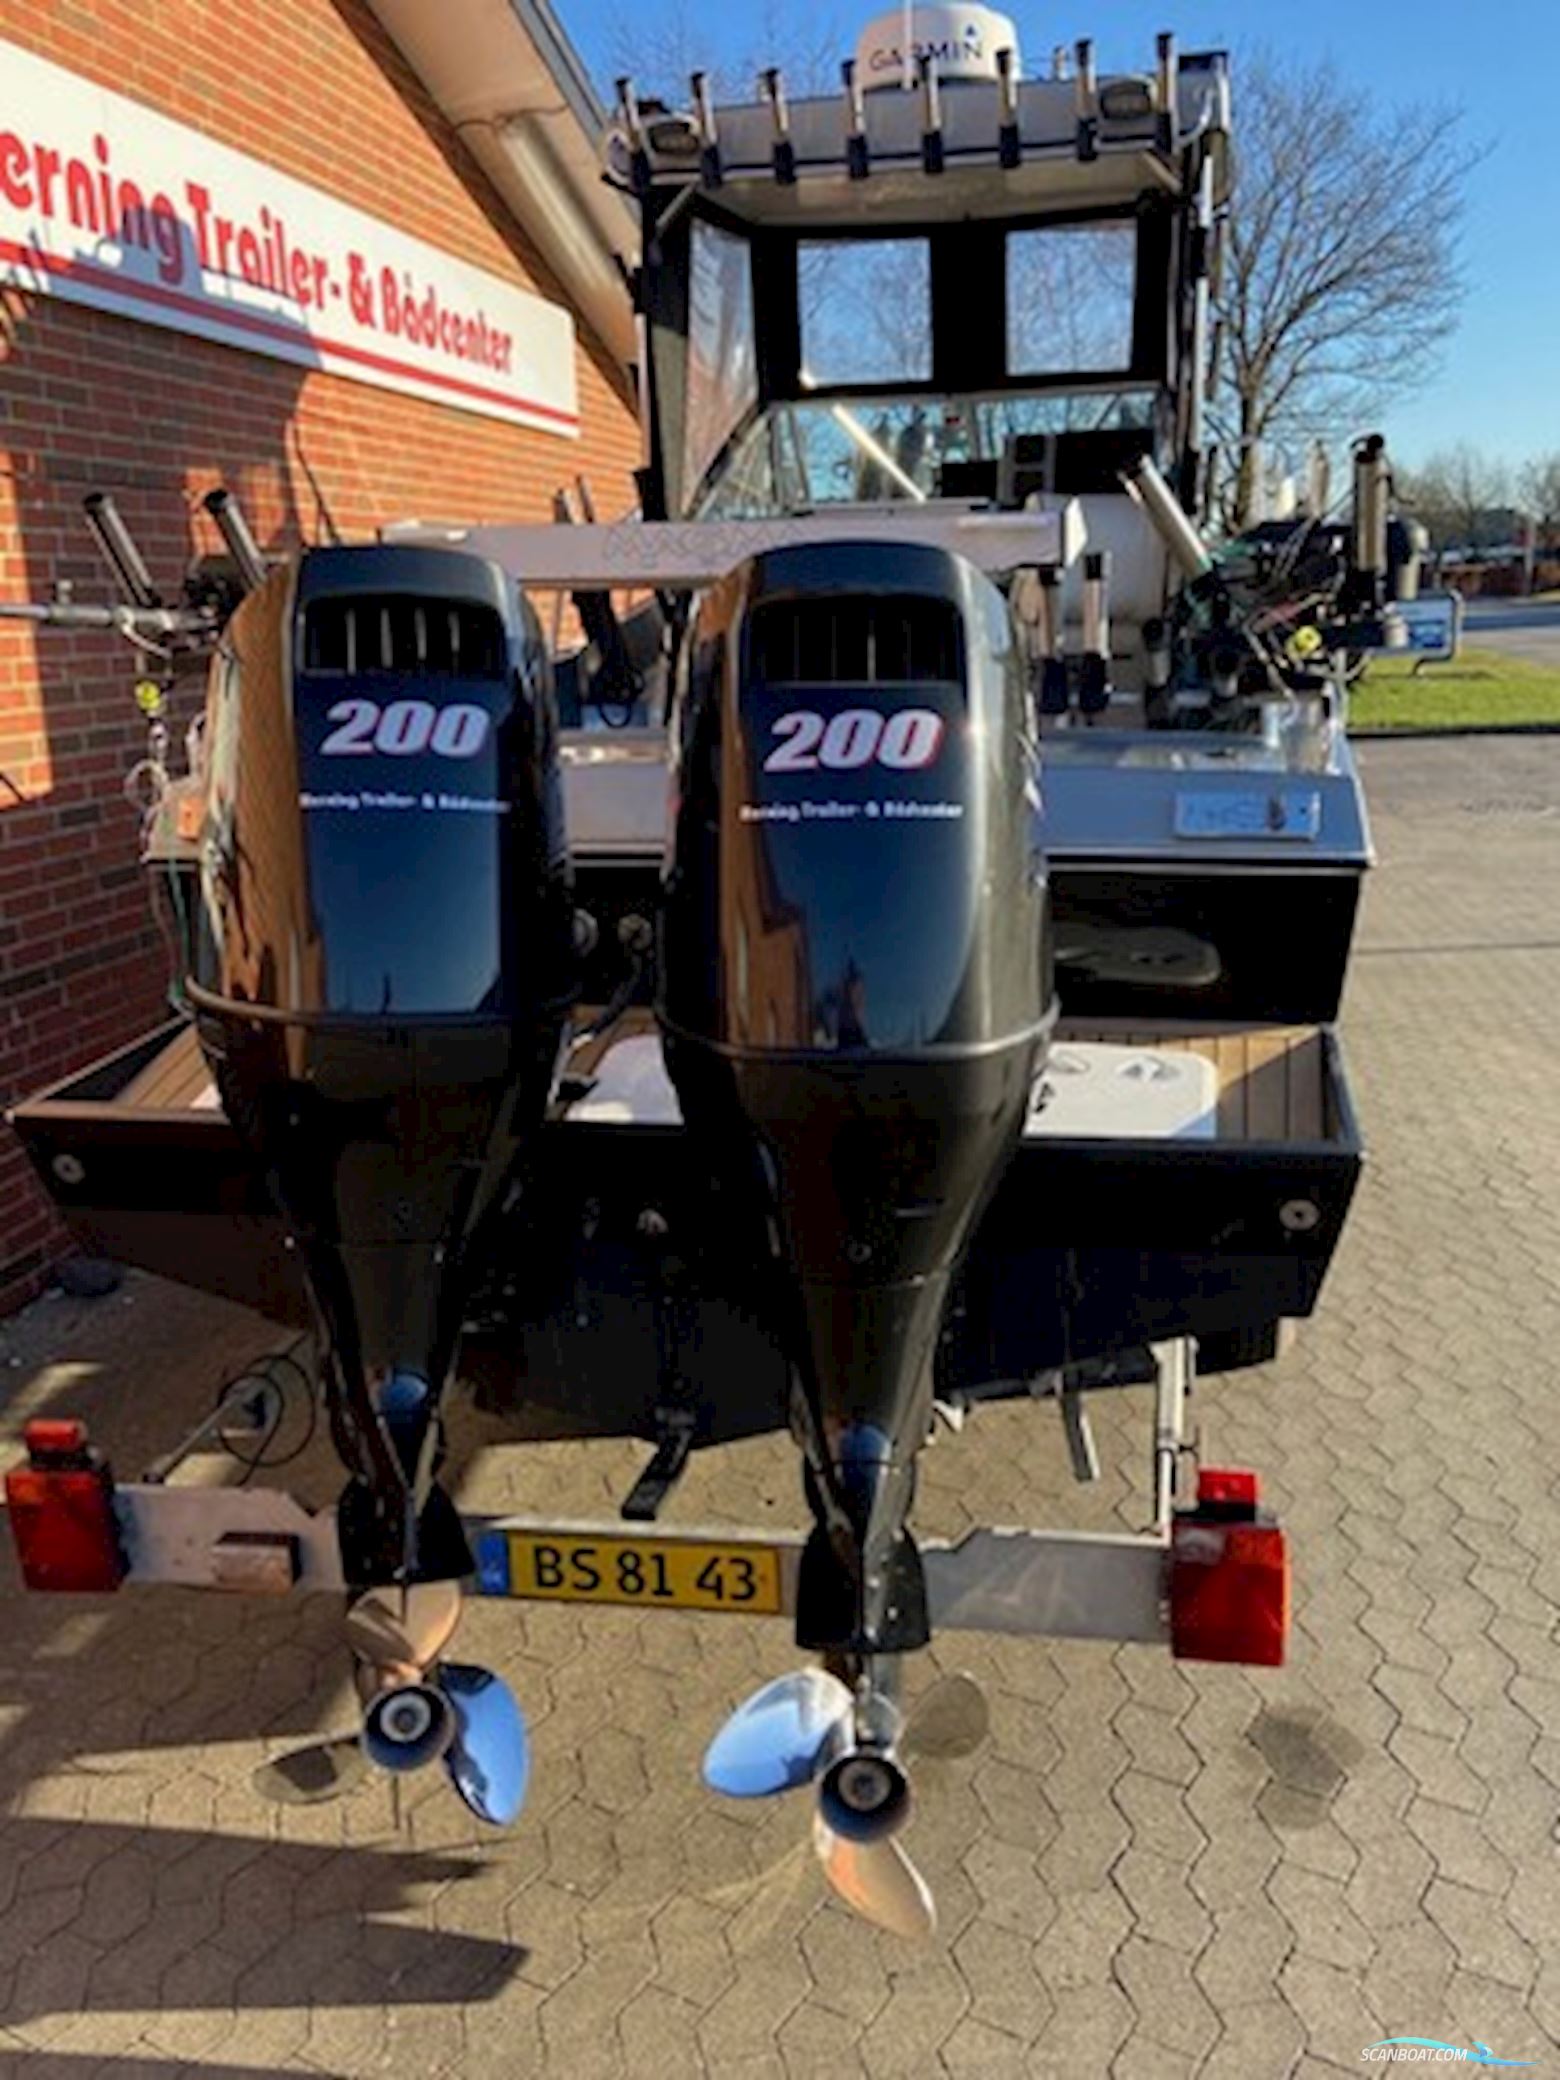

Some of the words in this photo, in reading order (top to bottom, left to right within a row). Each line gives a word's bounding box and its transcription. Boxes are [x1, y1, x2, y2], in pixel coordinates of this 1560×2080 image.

[185, 180, 341, 311] Trailer-
[346, 249, 377, 330] &
[320, 699, 490, 757] 200
[764, 709, 944, 772] 200
[533, 1546, 600, 1592] BS
[616, 1550, 674, 1597] 81
[696, 1556, 757, 1601] 43
